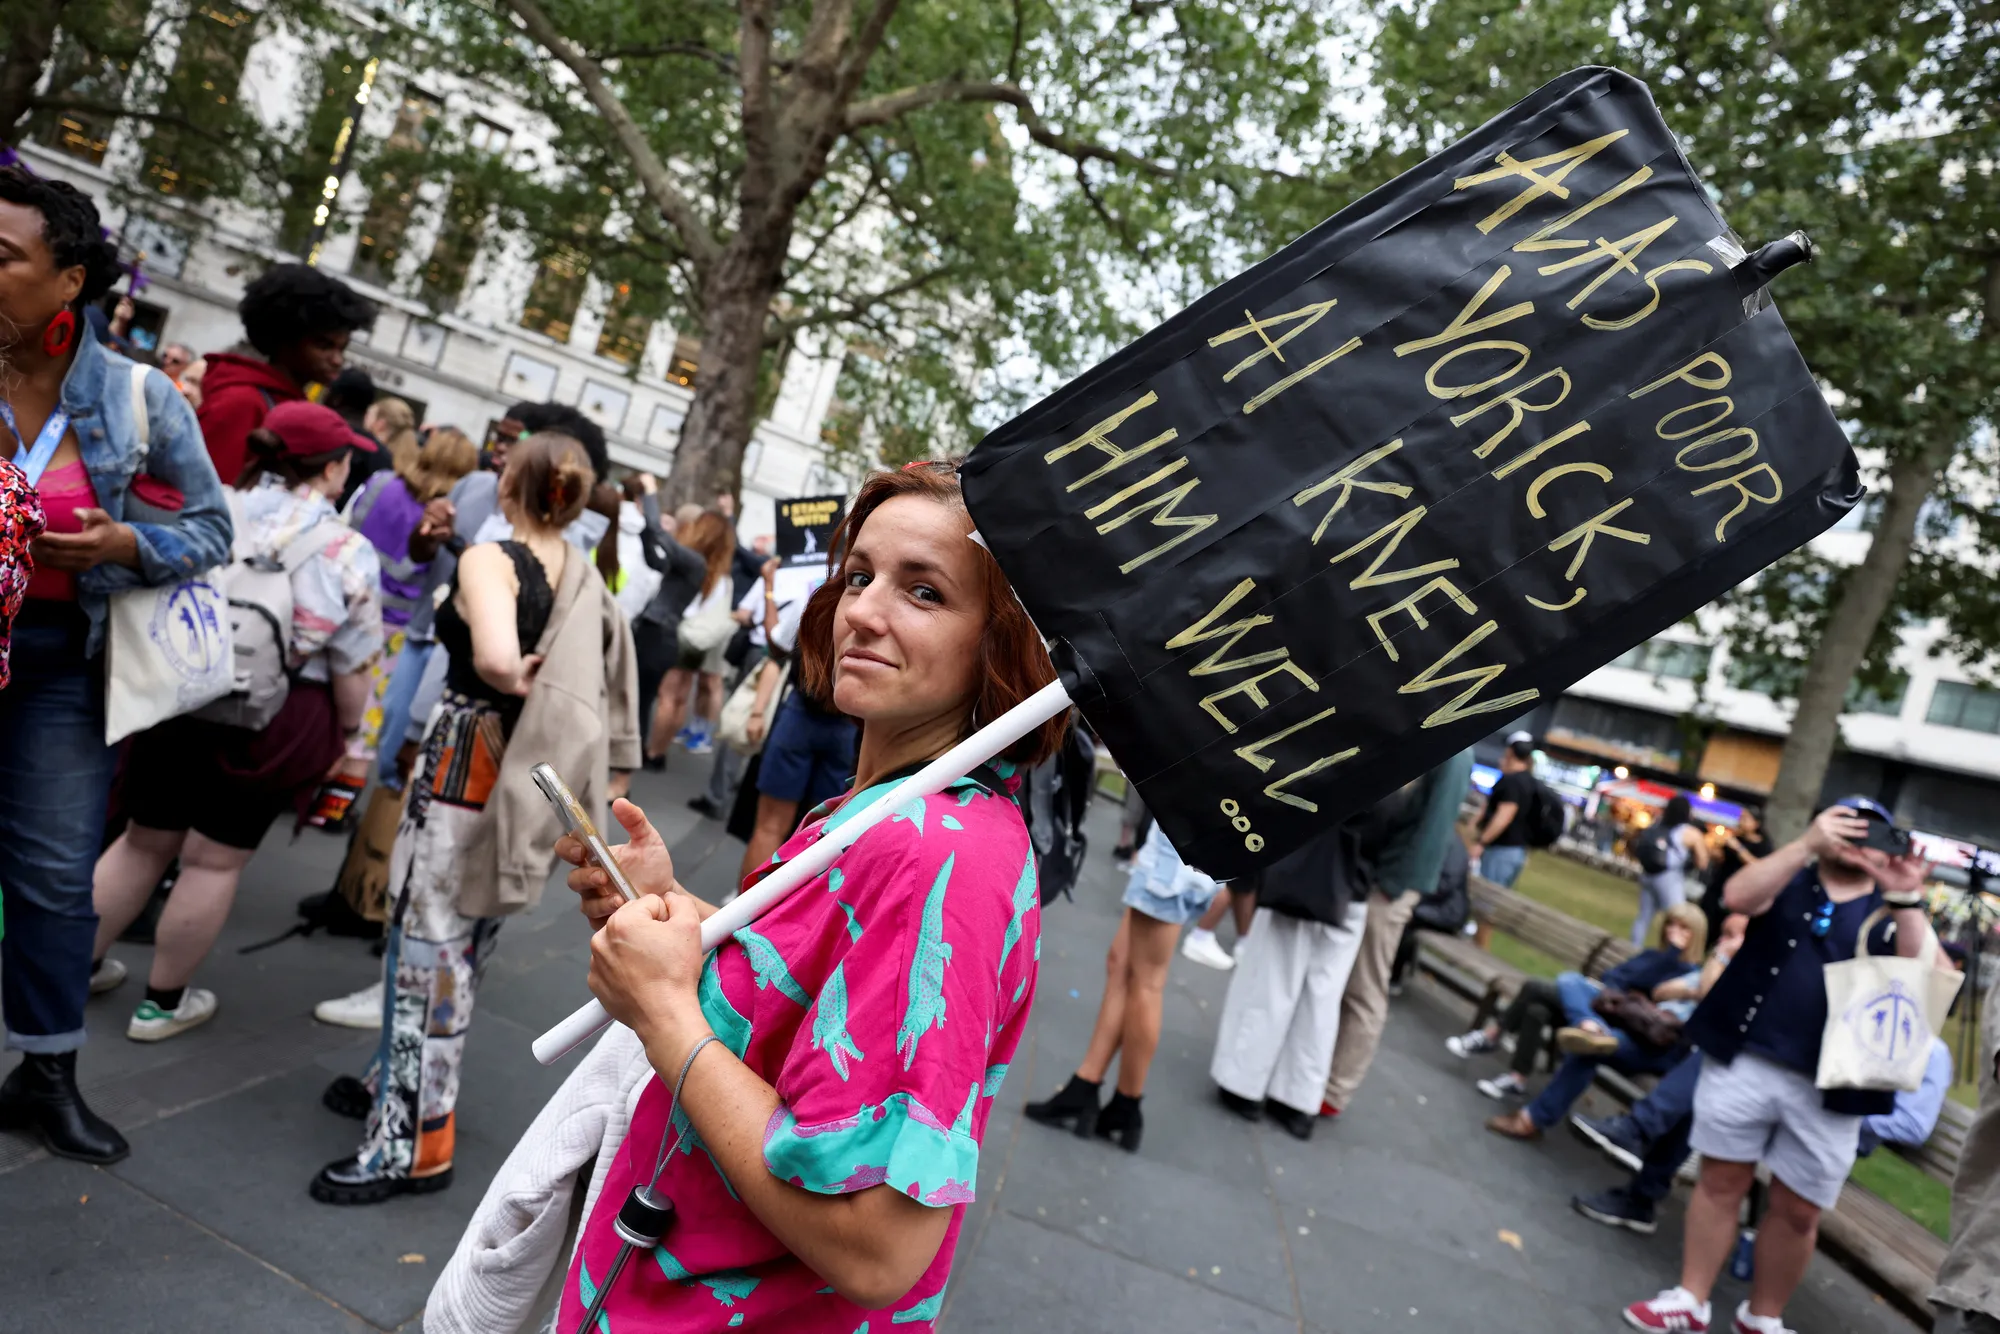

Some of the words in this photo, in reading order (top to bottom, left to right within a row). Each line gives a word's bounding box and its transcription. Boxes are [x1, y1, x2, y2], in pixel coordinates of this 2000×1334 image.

[1208, 298, 1363, 415] AI
[1293, 438, 1540, 729] KNEW
[1394, 265, 1651, 612] YORICK,
[1454, 129, 1712, 330] ALAS
[1629, 351, 1783, 543] POOR
[1045, 390, 1219, 574] HIM
[1165, 577, 1360, 812] WELL
